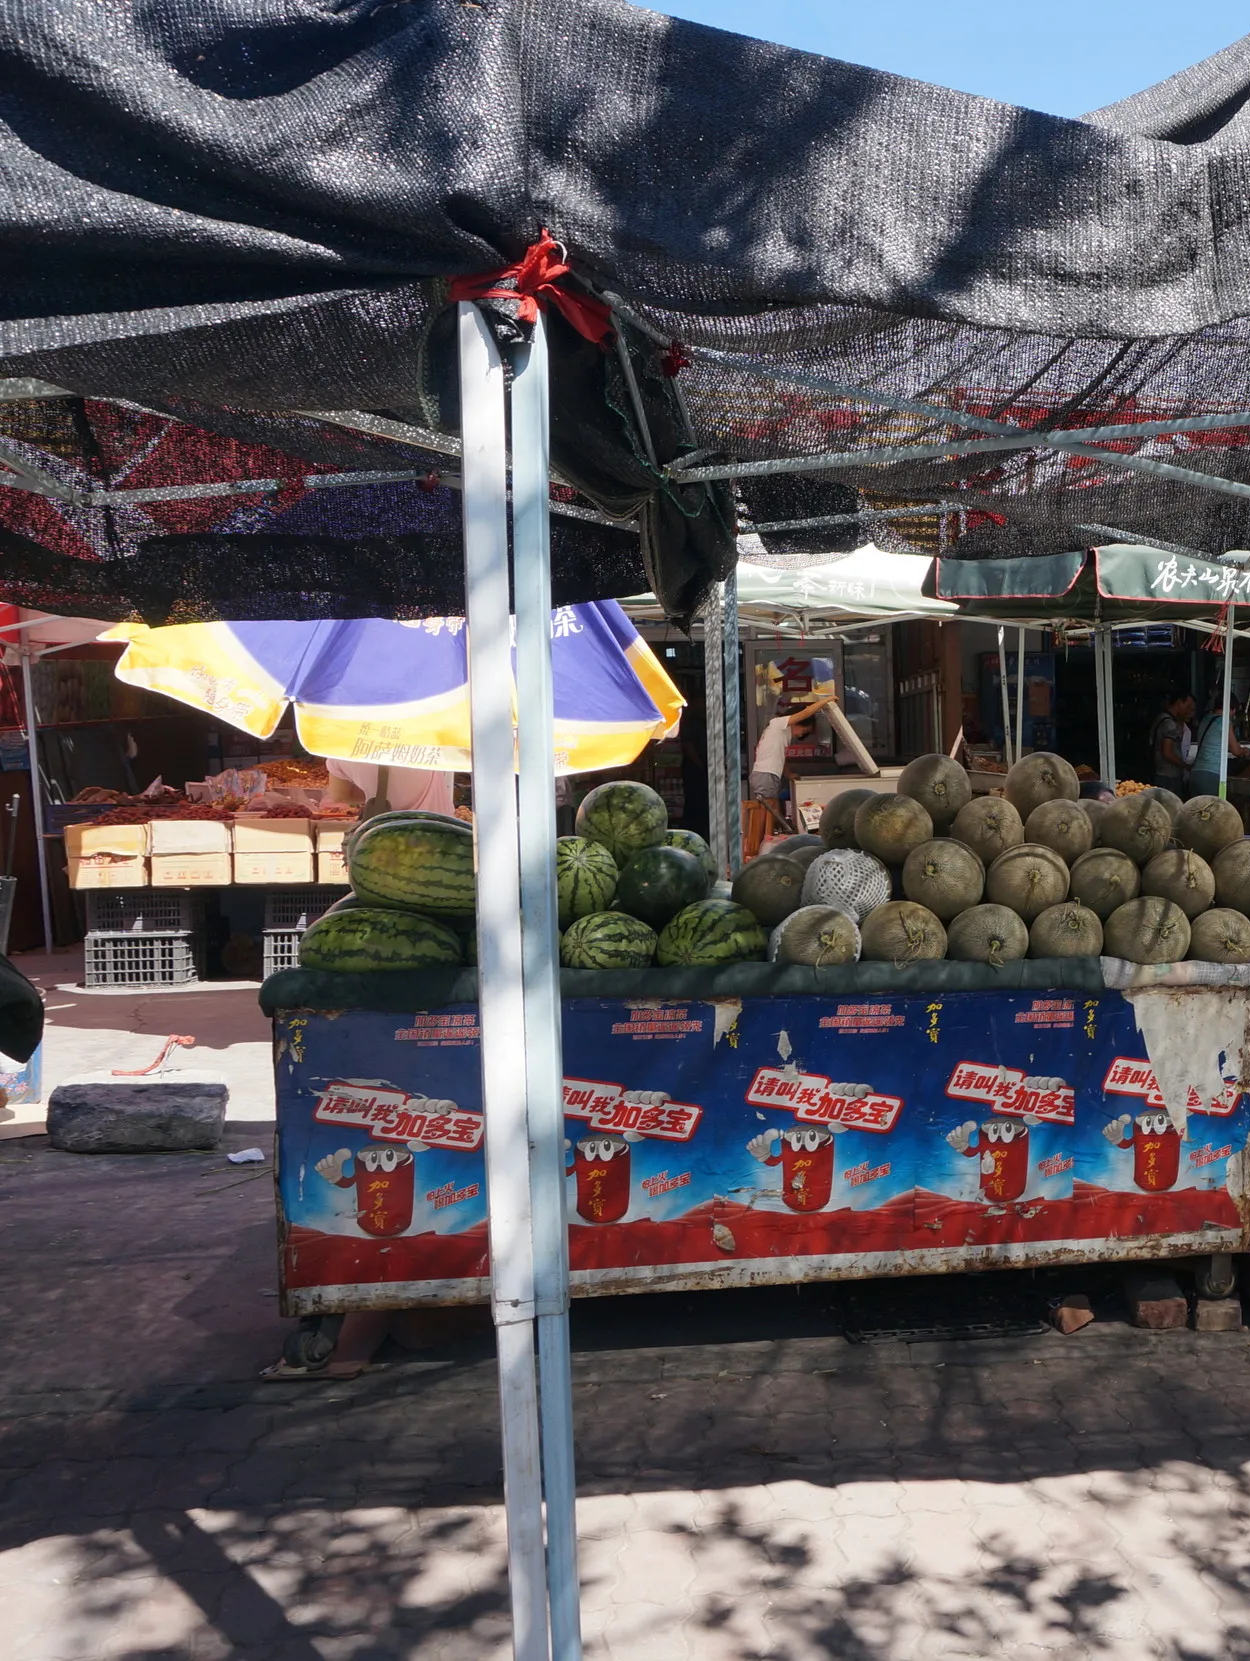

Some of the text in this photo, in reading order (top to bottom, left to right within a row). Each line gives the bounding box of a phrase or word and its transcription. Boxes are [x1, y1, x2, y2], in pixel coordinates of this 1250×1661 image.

[350, 737, 444, 766] 阿萨姆奶茶
[754, 1075, 893, 1127] 请叫我加多宝
